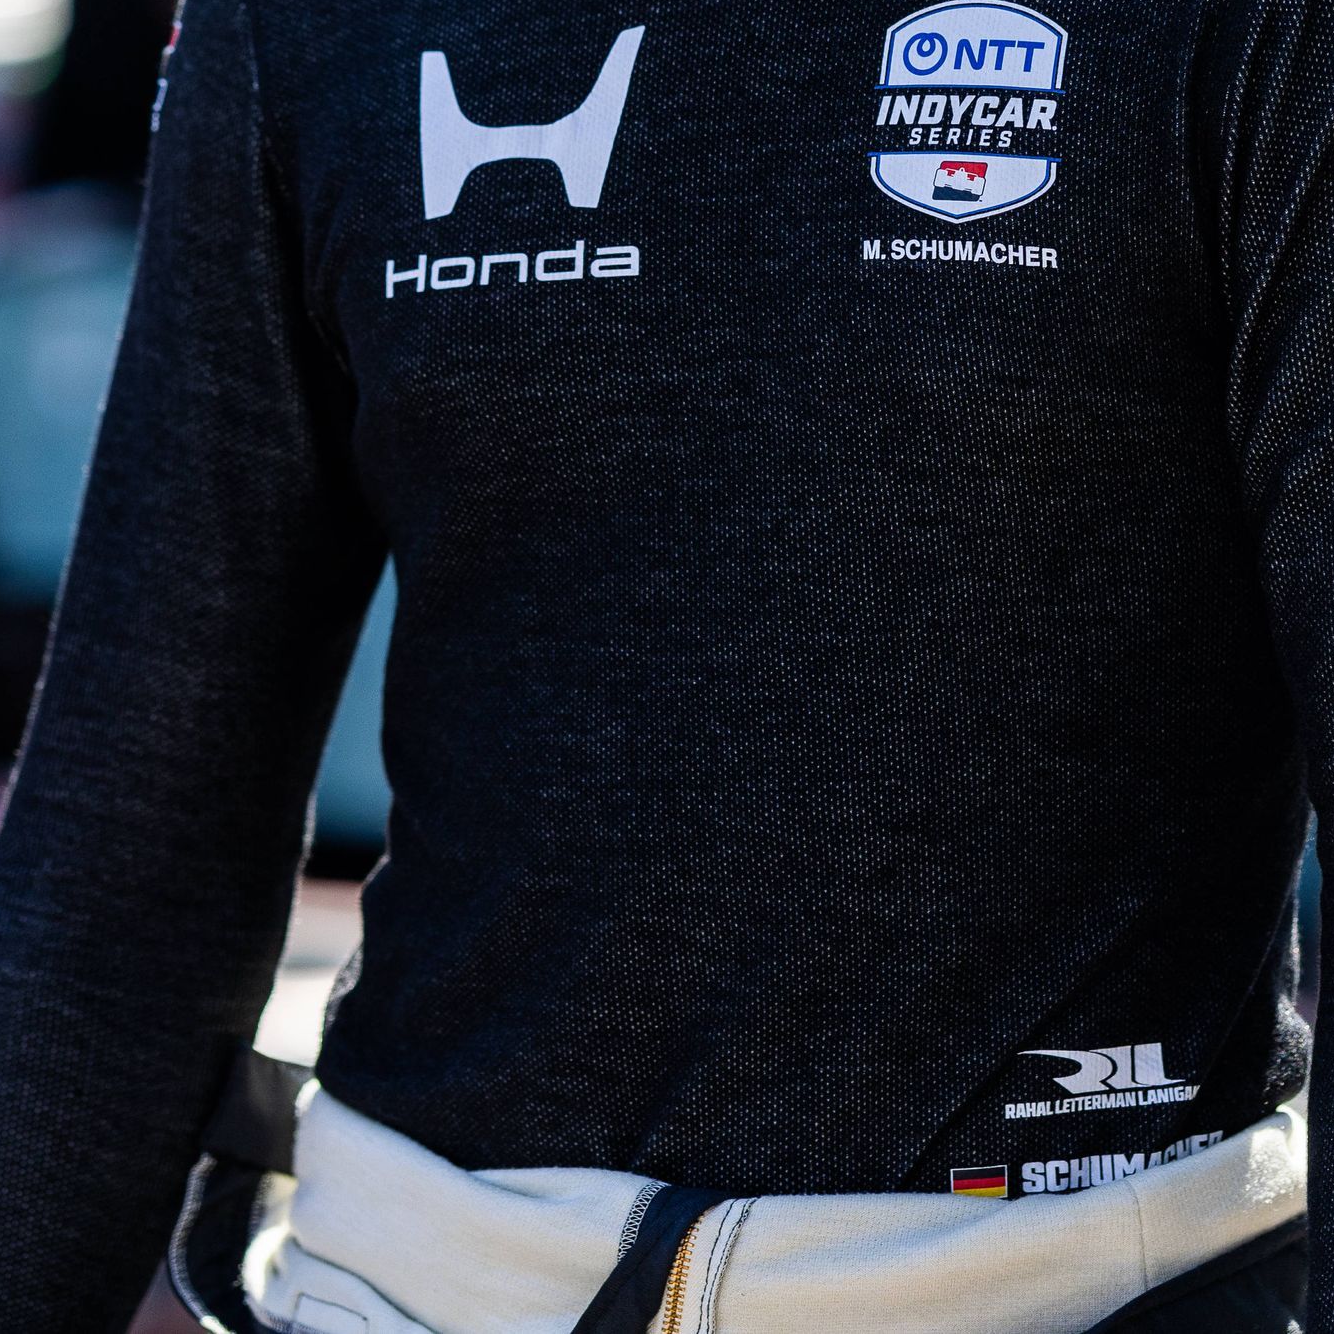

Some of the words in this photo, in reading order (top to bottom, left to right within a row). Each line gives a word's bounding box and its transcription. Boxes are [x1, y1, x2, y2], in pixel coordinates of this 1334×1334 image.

[953, 38, 1045, 73] NTT
[909, 127, 1013, 148] SERIES
[862, 239, 886, 261] M.
[891, 239, 1058, 268] SCHUMACHER
[385, 239, 640, 299] Honda
[1005, 1100, 1054, 1120] RAHAL
[1054, 1091, 1136, 1115] LETTERMAN
